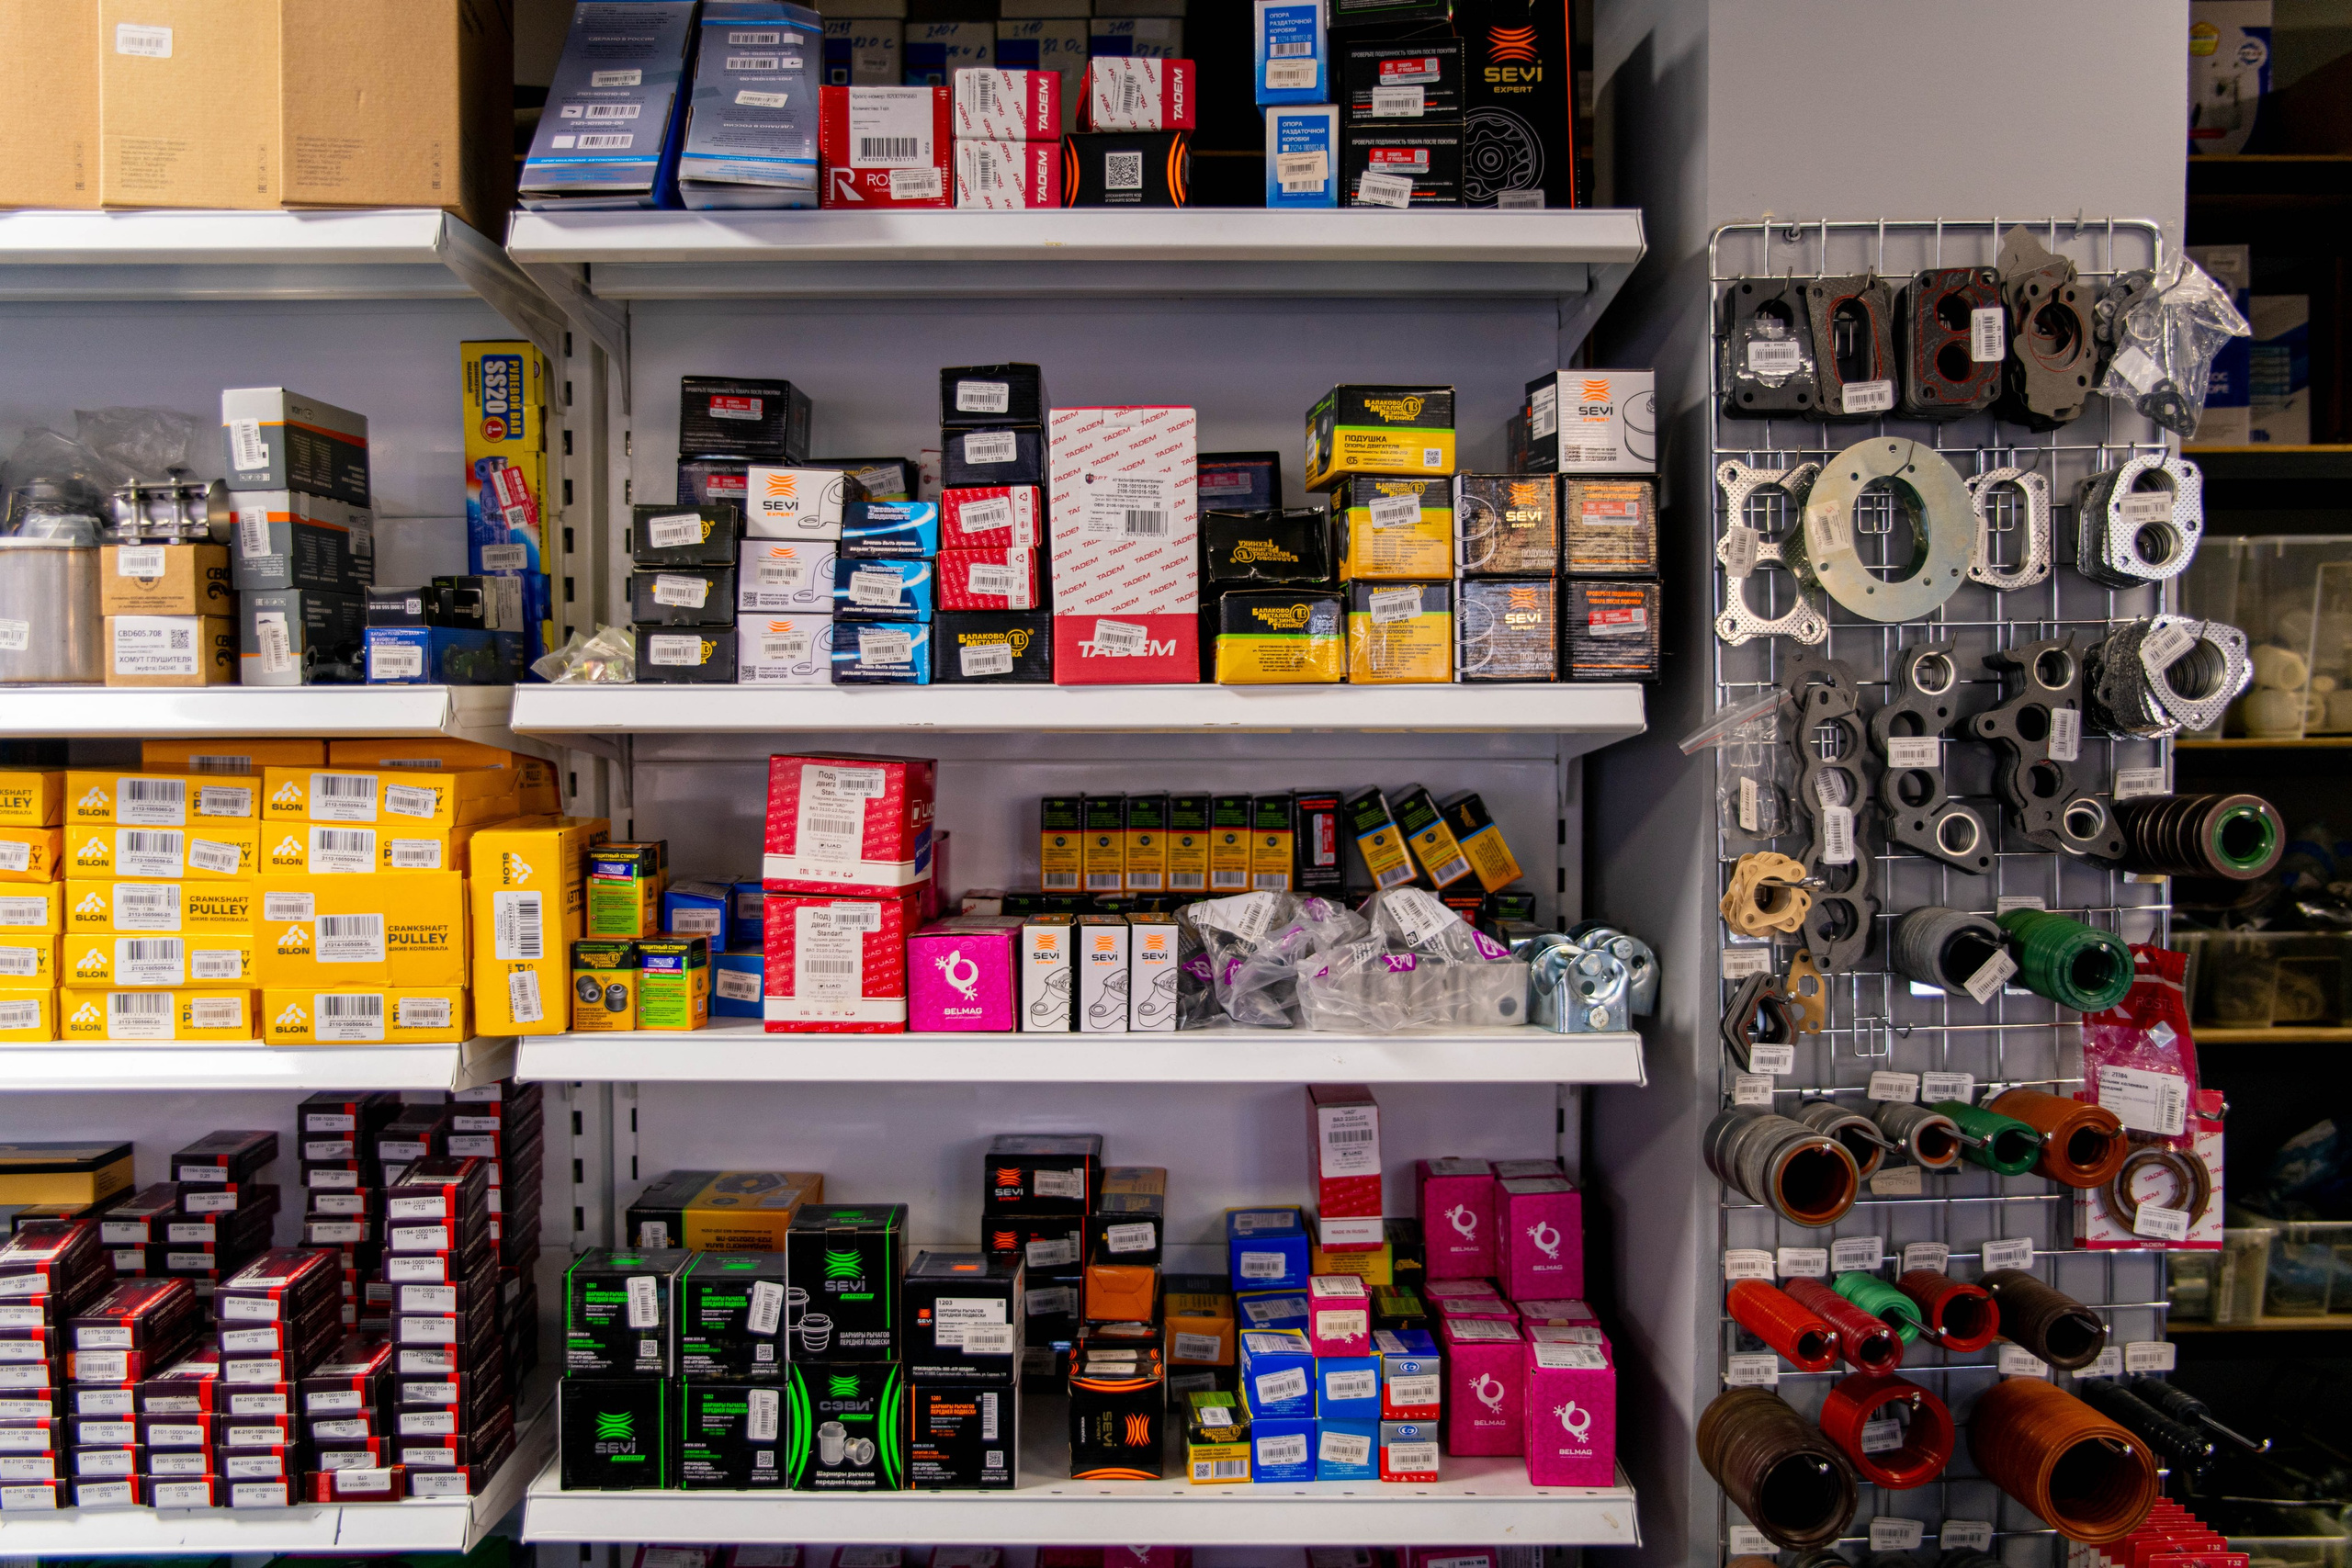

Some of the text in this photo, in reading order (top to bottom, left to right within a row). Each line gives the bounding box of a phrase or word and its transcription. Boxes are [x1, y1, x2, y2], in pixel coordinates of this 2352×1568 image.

[1173, 68, 1184, 121] TADEM
[1037, 77, 1048, 131] TADEM
[1037, 151, 1048, 204] TADEM
[485, 360, 507, 414] SS20
[508, 360, 522, 434] РУЛЕВОЙ ВАЛ
[1051, 412, 1079, 426] TADEM
[1077, 419, 1104, 434] TADEM
[1344, 434, 1386, 443] ПОДУШКА
[1521, 549, 1554, 558] ПОДУШКА
[958, 634, 1005, 643] БАЛАКОВО
[1520, 652, 1553, 661] ПОДУШКА
[1520, 662, 1553, 671] ДВИГАТЕЛЯ
[189, 905, 249, 915] PULLEY
[388, 933, 448, 944] PULLEY
[2099, 1084, 2122, 1092] передний
[2143, 1169, 2170, 1182] TADEM
[820, 1400, 870, 1411] СЭВИ
